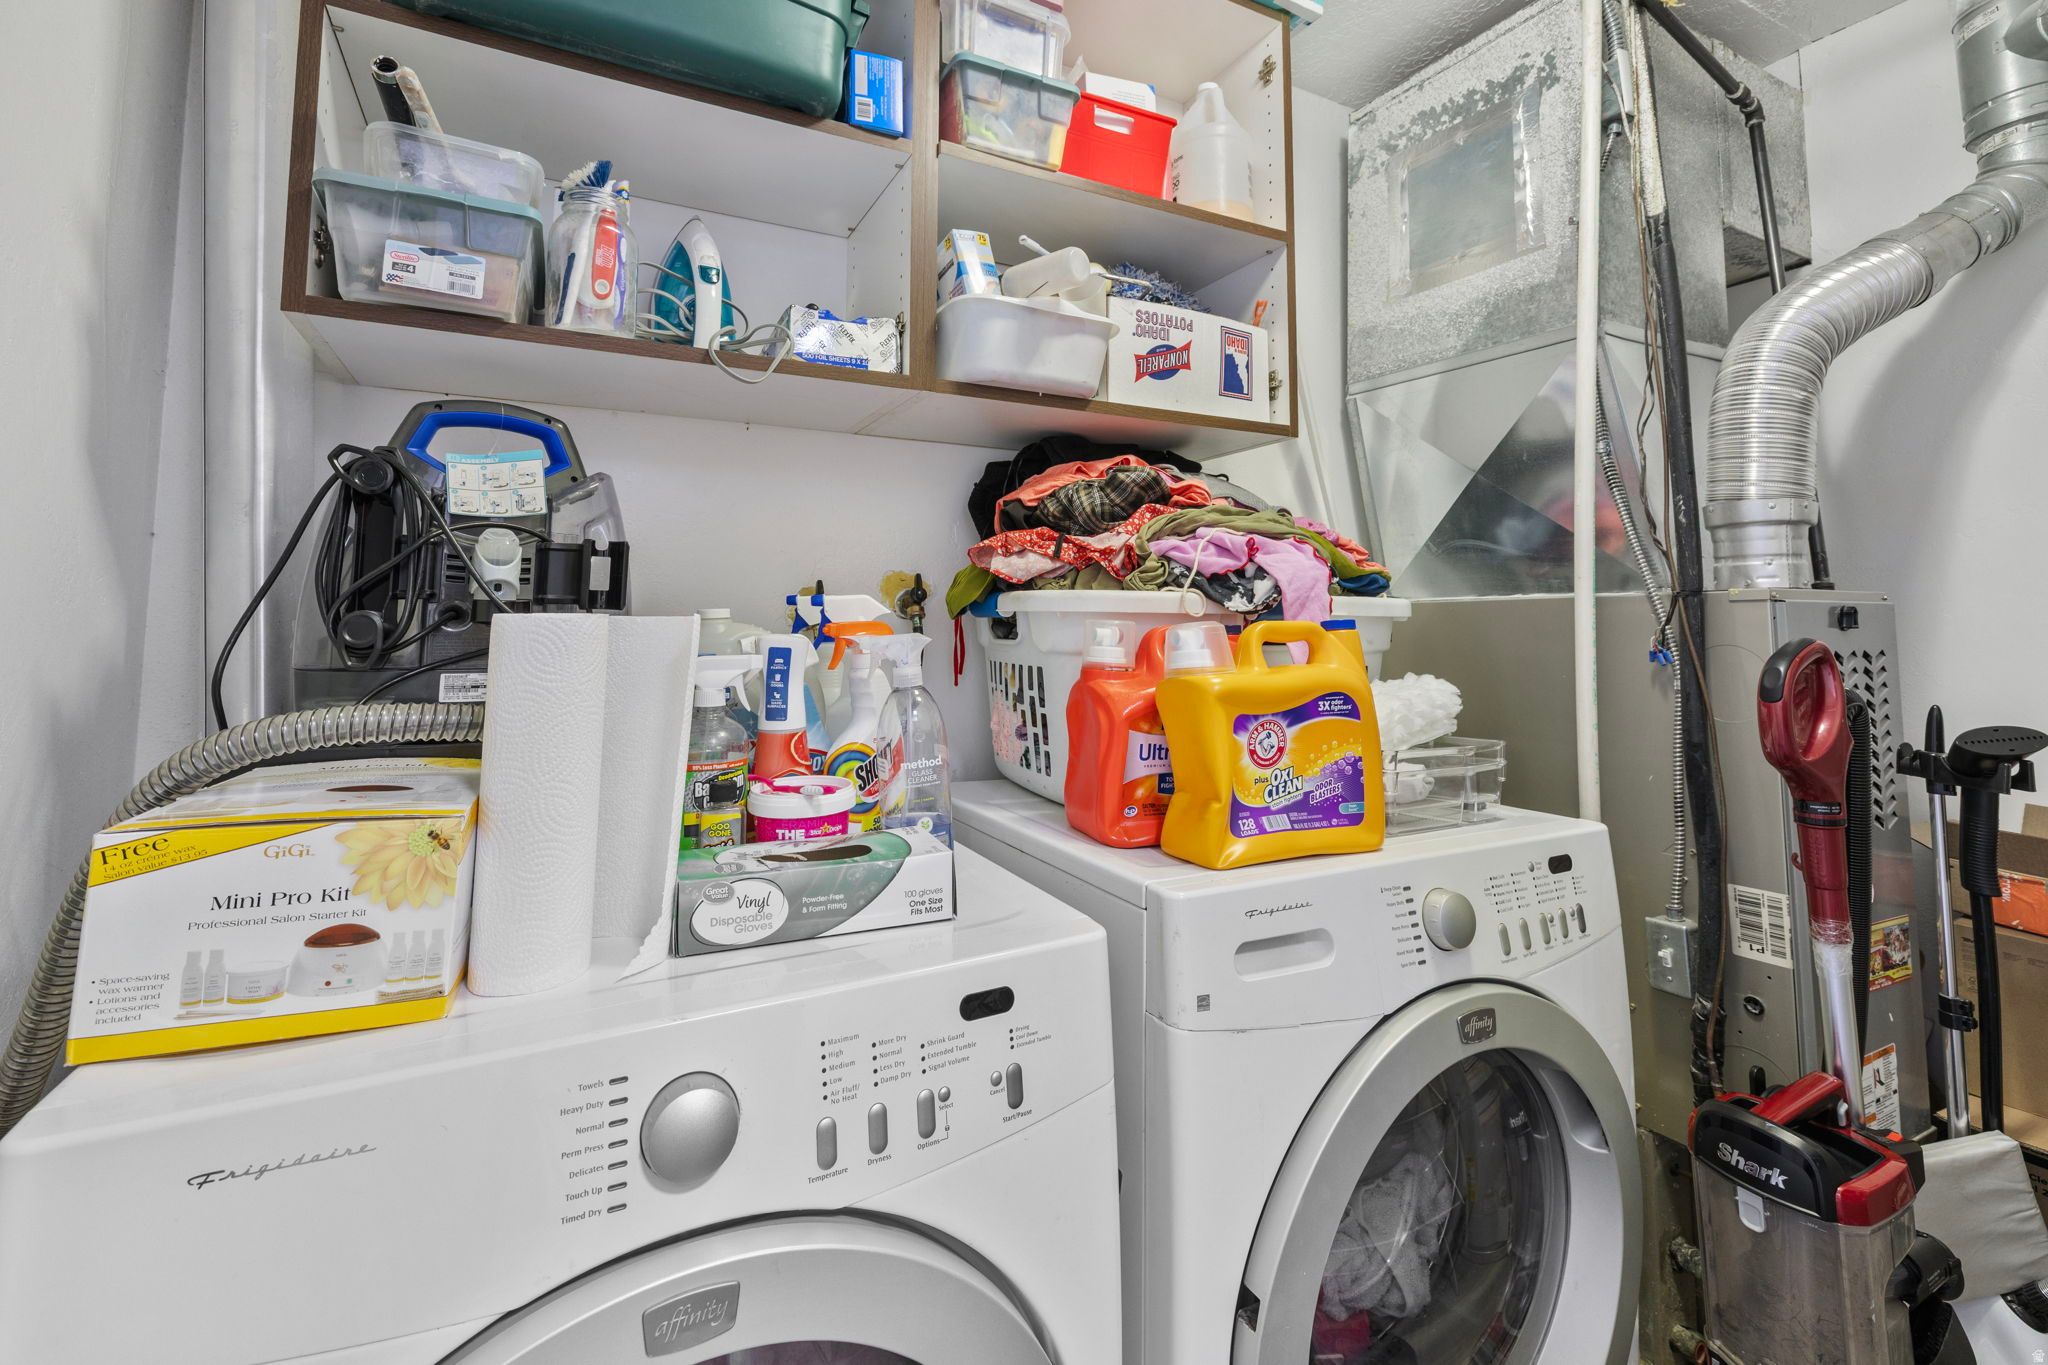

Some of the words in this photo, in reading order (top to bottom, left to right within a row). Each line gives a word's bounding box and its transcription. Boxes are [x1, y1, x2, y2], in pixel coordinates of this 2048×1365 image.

[1135, 308, 1193, 332] POTATOES
[1136, 324, 1170, 342] IDAHO
[1226, 334, 1248, 352] IDAHO
[1137, 350, 1190, 375] NONPAREIL
[1250, 731, 1259, 750] ARM
[1263, 722, 1285, 748] HAMMER
[1139, 743, 1170, 762] Ultr
[900, 754, 943, 770] method
[907, 773, 938, 785] CLEANER
[912, 769, 934, 777] GLASS
[1270, 766, 1294, 786] OXI
[1254, 776, 1269, 786] plus
[1314, 778, 1333, 793] ODOR
[1264, 775, 1304, 804] CLEAN
[1309, 783, 1342, 804] BLASTERS
[710, 822, 730, 830] GOO
[1238, 818, 1256, 831] 128
[776, 829, 805, 841] THE
[100, 838, 170, 866] Free
[174, 846, 197, 855] wax
[263, 843, 312, 860] GiGi
[138, 860, 168, 871] value
[705, 886, 729, 896] Great
[904, 889, 918, 899] 100
[919, 887, 944, 899] gloves
[210, 891, 262, 912] Mini
[270, 891, 312, 908] Pro
[321, 886, 352, 903] Kit
[736, 890, 772, 913] Vinyl
[802, 892, 845, 905] Powder-Free
[908, 897, 925, 908] One
[926, 896, 944, 906] Size
[802, 906, 808, 914] &
[808, 904, 826, 914] Form
[827, 902, 848, 912] Fitting
[910, 907, 922, 916] Fits
[924, 904, 944, 914] Most
[1244, 900, 1313, 920] Frigidaire
[187, 916, 267, 931] Professional
[270, 913, 306, 926] Salon
[308, 909, 349, 922] Starter
[351, 908, 367, 918] Kit
[710, 911, 773, 930] Disposable
[734, 921, 773, 935] Gloves
[98, 972, 171, 986] Space-saving
[98, 987, 121, 995] wax
[123, 983, 165, 993] warmer
[97, 995, 137, 1005] Lotions
[140, 992, 161, 1001] and
[95, 1003, 160, 1015] accessories
[95, 1013, 142, 1025] included
[1464, 1015, 1493, 1038] affinity
[827, 1034, 860, 1046] Maximum
[878, 1038, 894, 1047] More
[896, 1034, 907, 1042] Dry
[926, 1037, 946, 1047] Shrink
[947, 1031, 966, 1042] Guard
[828, 1049, 844, 1059] High
[879, 1046, 903, 1059] Normal
[927, 1047, 954, 1060] Extended
[955, 1040, 977, 1052] Tumble
[828, 1060, 856, 1072] Medium
[879, 1063, 893, 1072] Less
[894, 1060, 906, 1069] Dry
[928, 1060, 947, 1072] Signal
[947, 1055, 970, 1067] Volume
[829, 1077, 843, 1085] Low
[880, 1074, 899, 1085] Damp
[900, 1071, 912, 1079] Dry
[578, 1079, 605, 1092] Towels
[989, 1085, 1006, 1097] Cancel
[830, 1089, 841, 1097] Air
[830, 1097, 840, 1105] No
[842, 1093, 858, 1102] Heat
[560, 1105, 584, 1117] Heavy
[585, 1100, 604, 1111] Duty
[938, 1102, 954, 1112] Select
[1002, 1108, 1033, 1124] Start/Pause
[575, 1121, 605, 1136] Normal
[917, 1138, 941, 1151] Options
[561, 1149, 582, 1160] Perm
[584, 1144, 605, 1154] Press
[867, 1153, 892, 1167] Dryness
[1716, 1141, 1790, 1191] Shark
[187, 1144, 377, 1191] Frigidaire
[569, 1164, 605, 1180] Delicates
[807, 1167, 849, 1185] Temperature
[565, 1188, 590, 1202] Touch
[591, 1186, 603, 1196] Up
[560, 1211, 586, 1225] Timed
[588, 1208, 602, 1219] Dry
[655, 1298, 729, 1344] affinity
